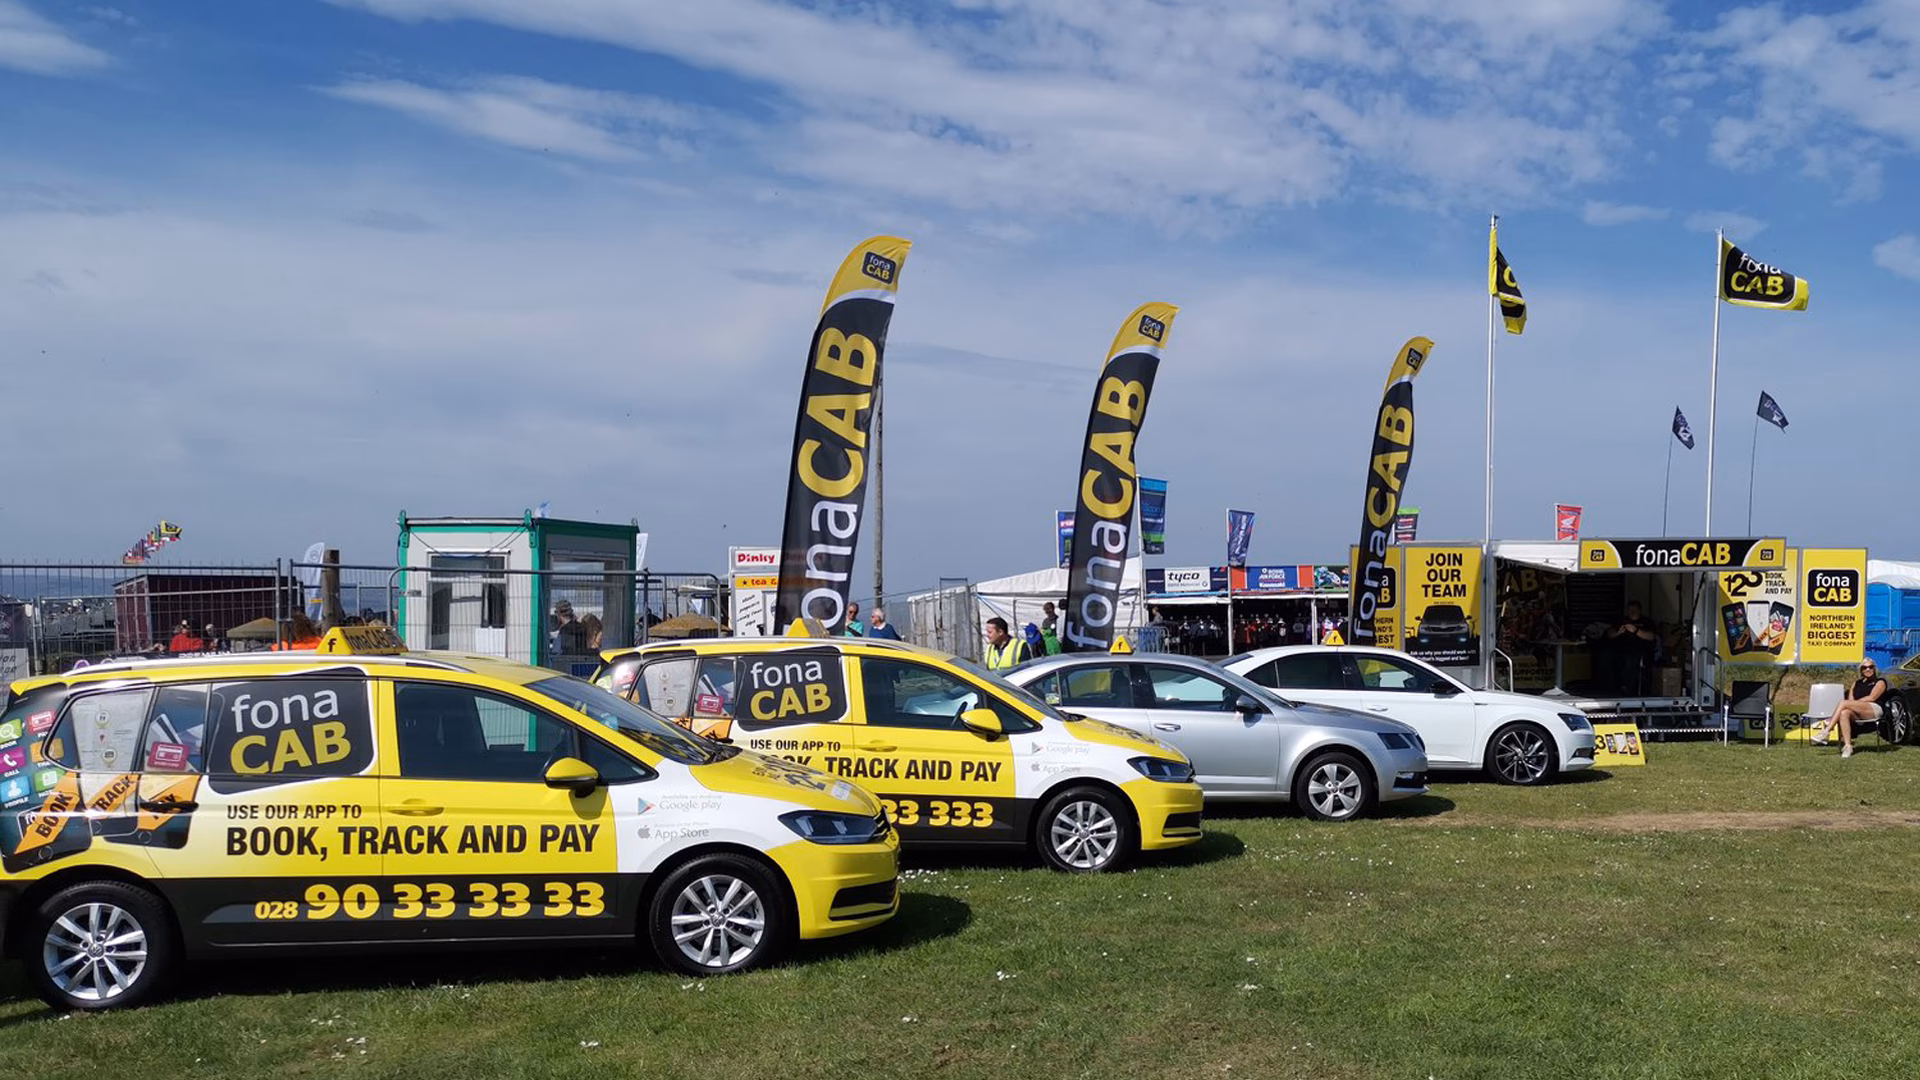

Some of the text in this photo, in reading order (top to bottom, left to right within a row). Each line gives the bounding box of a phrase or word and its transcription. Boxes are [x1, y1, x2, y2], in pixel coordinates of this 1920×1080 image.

[869, 255, 890, 270] fona
[1739, 252, 1782, 275] fona
[867, 264, 890, 280] CAB
[1731, 271, 1784, 296] CAB
[1066, 375, 1146, 650] fonaCAB
[1354, 403, 1414, 639] fonaCAB
[737, 553, 775, 563] Dinky
[1426, 553, 1463, 567] JOIN
[1636, 543, 1731, 566] fonaCAB
[1168, 572, 1200, 583] tyco
[1427, 569, 1461, 582] OUR
[1816, 573, 1850, 587] fona
[1422, 584, 1467, 598] TEAM
[1813, 588, 1852, 602] CAB
[1807, 631, 1856, 639] BIGGEST
[327, 638, 337, 653] f
[750, 661, 823, 689] fona
[750, 683, 832, 721] CAB
[231, 689, 340, 733] fona
[230, 721, 352, 776] CAB
[750, 739, 841, 752] USE OUR APP TO
[4, 769, 20, 778] CALL
[825, 757, 898, 779] TRACK
[905, 760, 952, 781] AND
[961, 762, 1002, 783] PAY
[91, 774, 134, 813] TRACK
[227, 805, 362, 820] USE OUR APP TO
[659, 800, 722, 811] Google play
[35, 790, 74, 838] BOOK
[929, 801, 993, 828] 333
[654, 827, 709, 841] App Store
[227, 824, 601, 861] BOOK, TRACK AND PAY
[255, 882, 605, 920] 028 90 33 33 33
